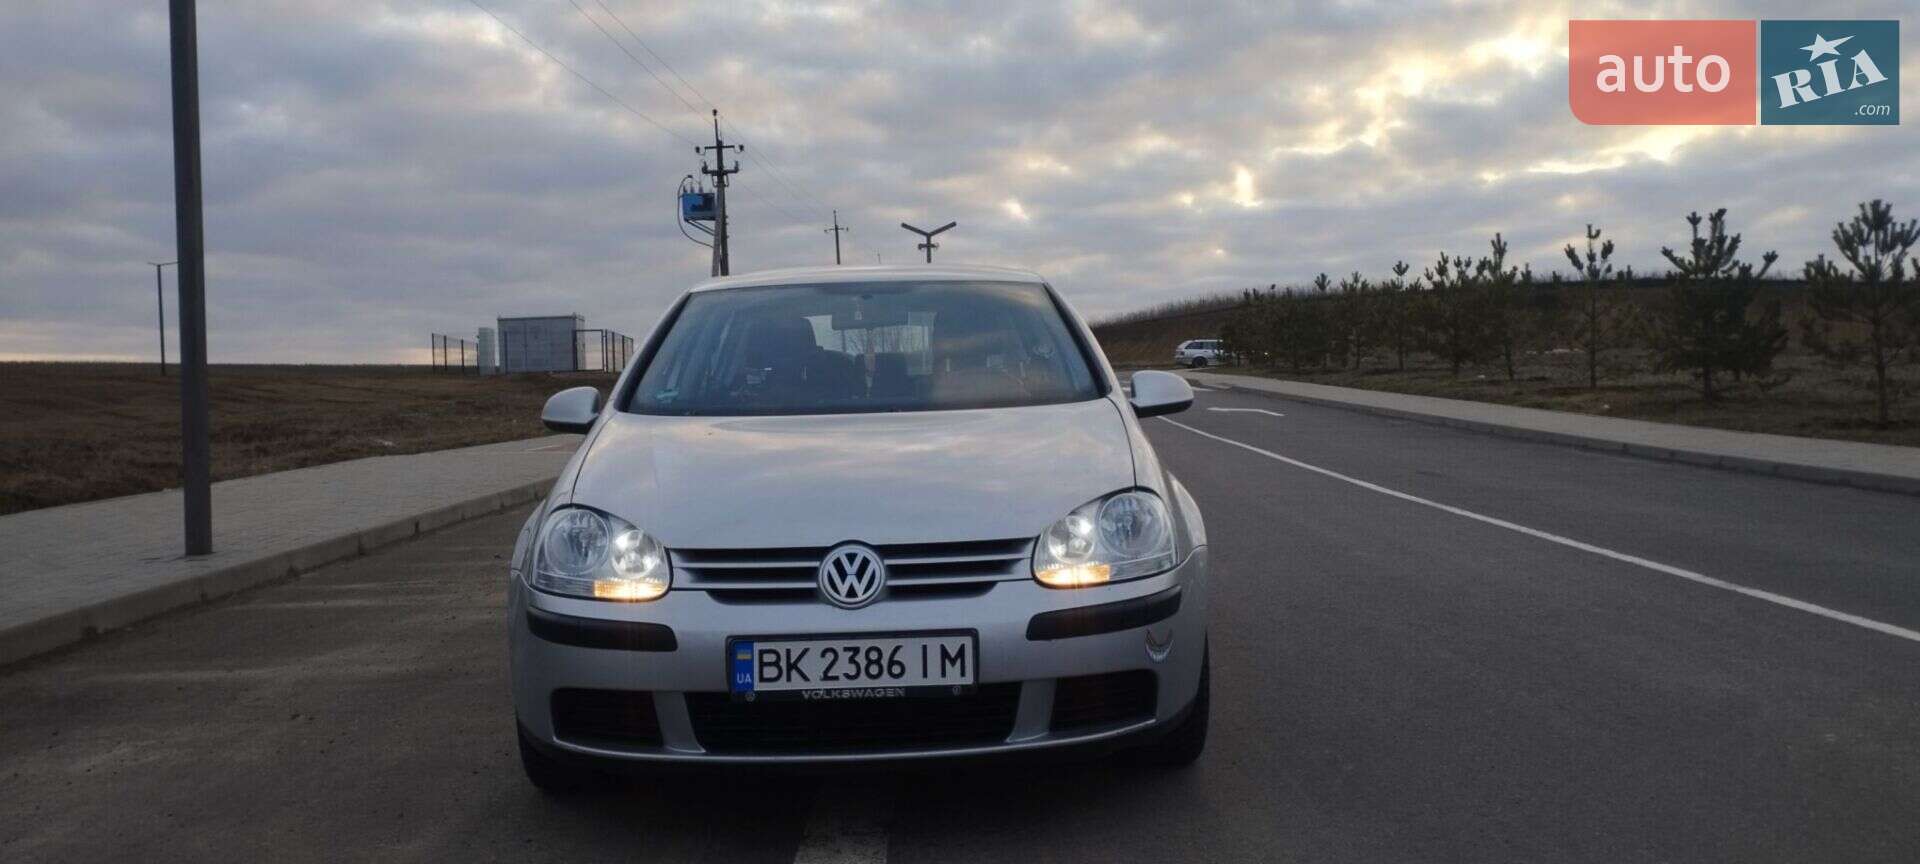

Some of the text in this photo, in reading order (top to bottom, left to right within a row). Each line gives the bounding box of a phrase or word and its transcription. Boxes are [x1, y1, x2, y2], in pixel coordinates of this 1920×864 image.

[758, 644, 966, 683] BK 2386 IM
[736, 672, 752, 684] UA
[802, 687, 905, 699] VOLKSWAGEN
